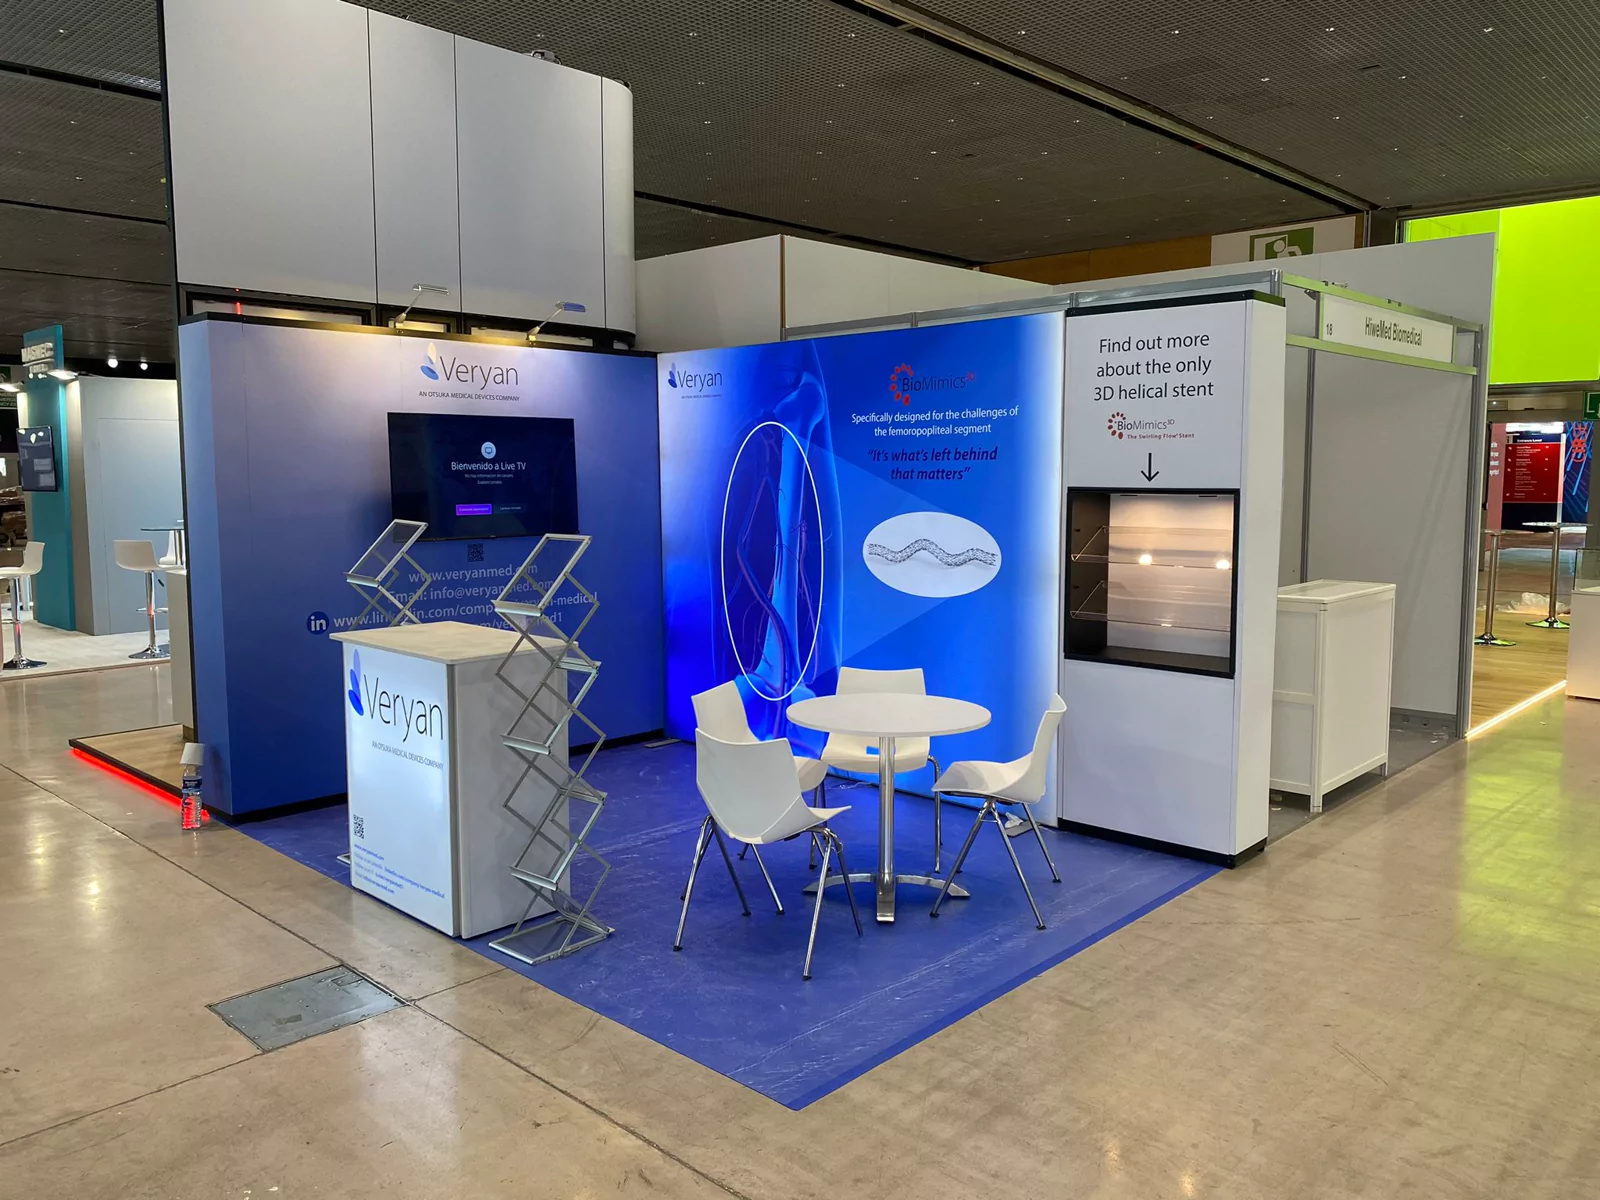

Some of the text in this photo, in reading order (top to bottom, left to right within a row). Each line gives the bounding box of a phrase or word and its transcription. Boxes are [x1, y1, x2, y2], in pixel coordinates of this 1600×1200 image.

[1326, 316, 1423, 346] 18 HiweMed Biomedical
[1099, 334, 1210, 354] Find out more
[439, 355, 519, 391] Veryan
[1096, 355, 1212, 378] about the only
[677, 369, 723, 393] Veryan
[1093, 381, 1214, 401] 3D helical stent
[450, 392, 474, 400] MEDICAL
[474, 393, 496, 401] DEVICES
[495, 394, 520, 402] COMPANY
[851, 404, 1020, 425] Specifically designed for the challenges of
[874, 423, 992, 438] the femoropopliteal segment
[891, 447, 928, 462] what's
[930, 447, 951, 462] left
[953, 445, 998, 461] behind
[450, 461, 527, 471] Bienvenido a Live TV
[890, 466, 971, 480] that matters"
[408, 564, 538, 583] www.veryanmed.m
[310, 615, 327, 631] in
[363, 673, 444, 743] Veryan
